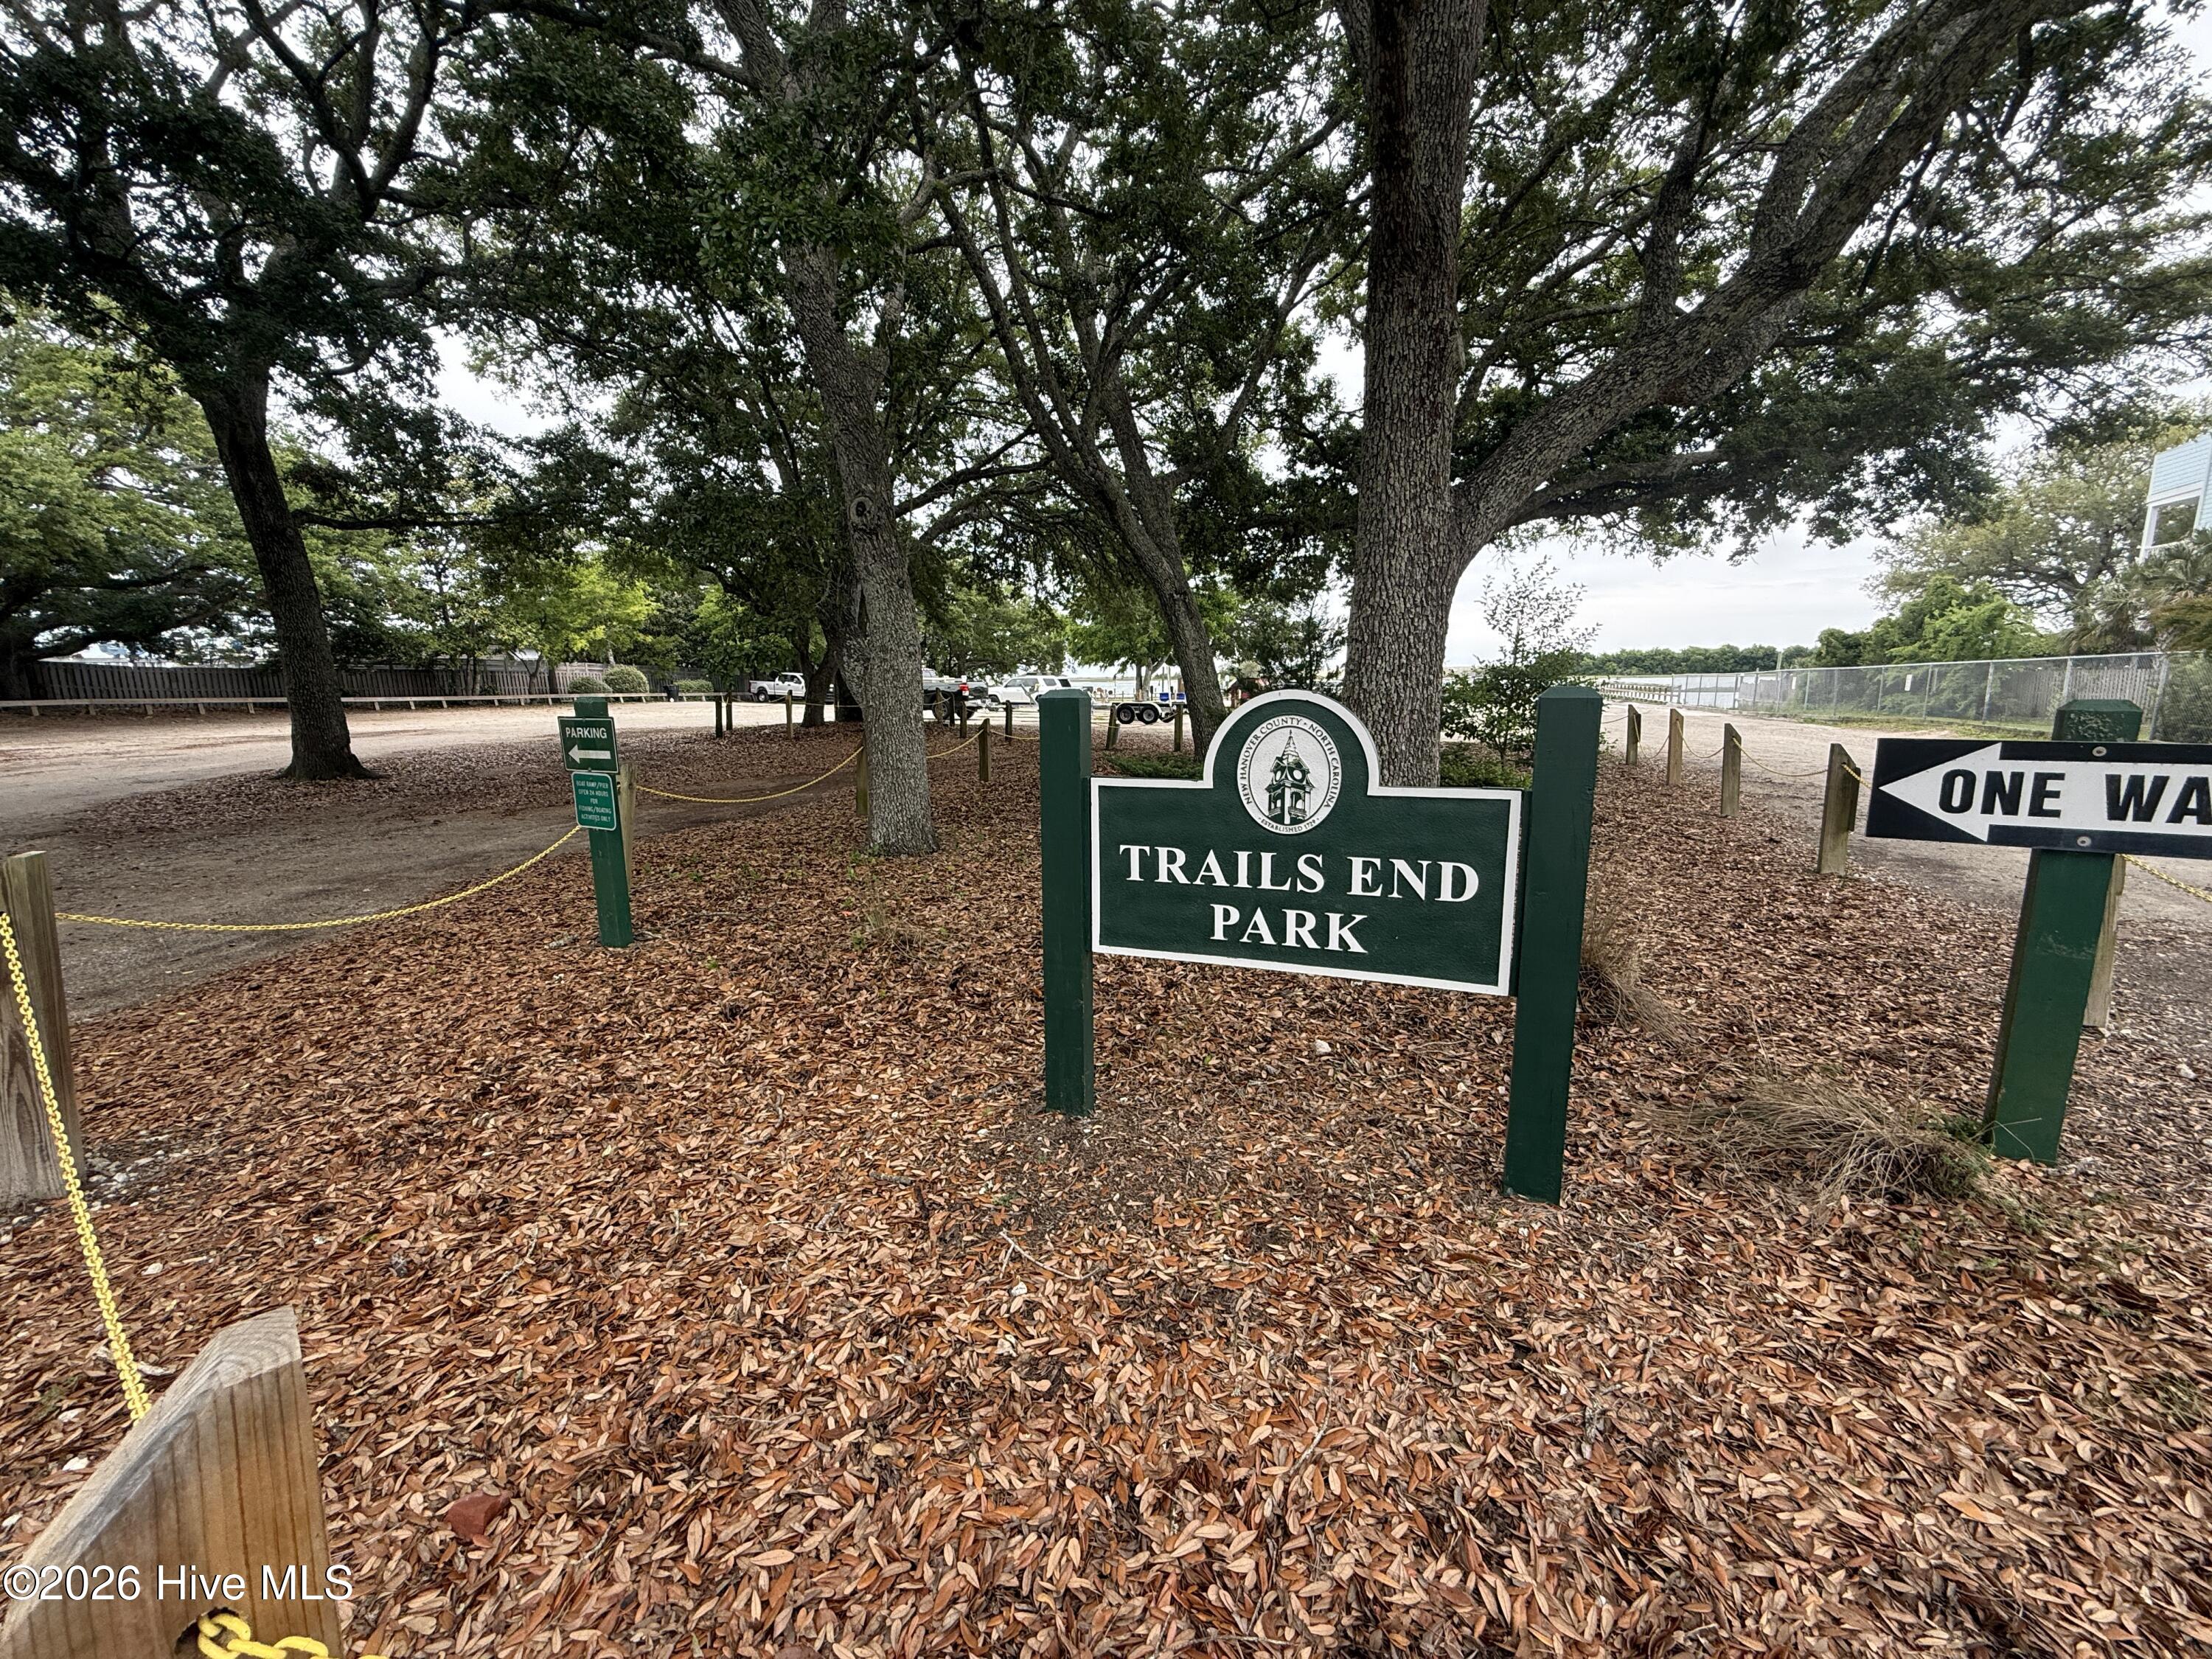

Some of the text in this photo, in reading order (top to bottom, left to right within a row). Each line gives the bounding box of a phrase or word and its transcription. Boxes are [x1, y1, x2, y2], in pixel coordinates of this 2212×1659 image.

[565, 726, 608, 739] PARKING
[1239, 717, 1303, 804] NEW HANOVER COUNTY
[1308, 723, 1340, 808] NORTH CAROLINA
[1938, 768, 2066, 818] ONE
[1262, 818, 1303, 832] ESTABLISHED
[1119, 844, 1479, 903] TRAILS END
[1209, 903, 1368, 954] PARK
